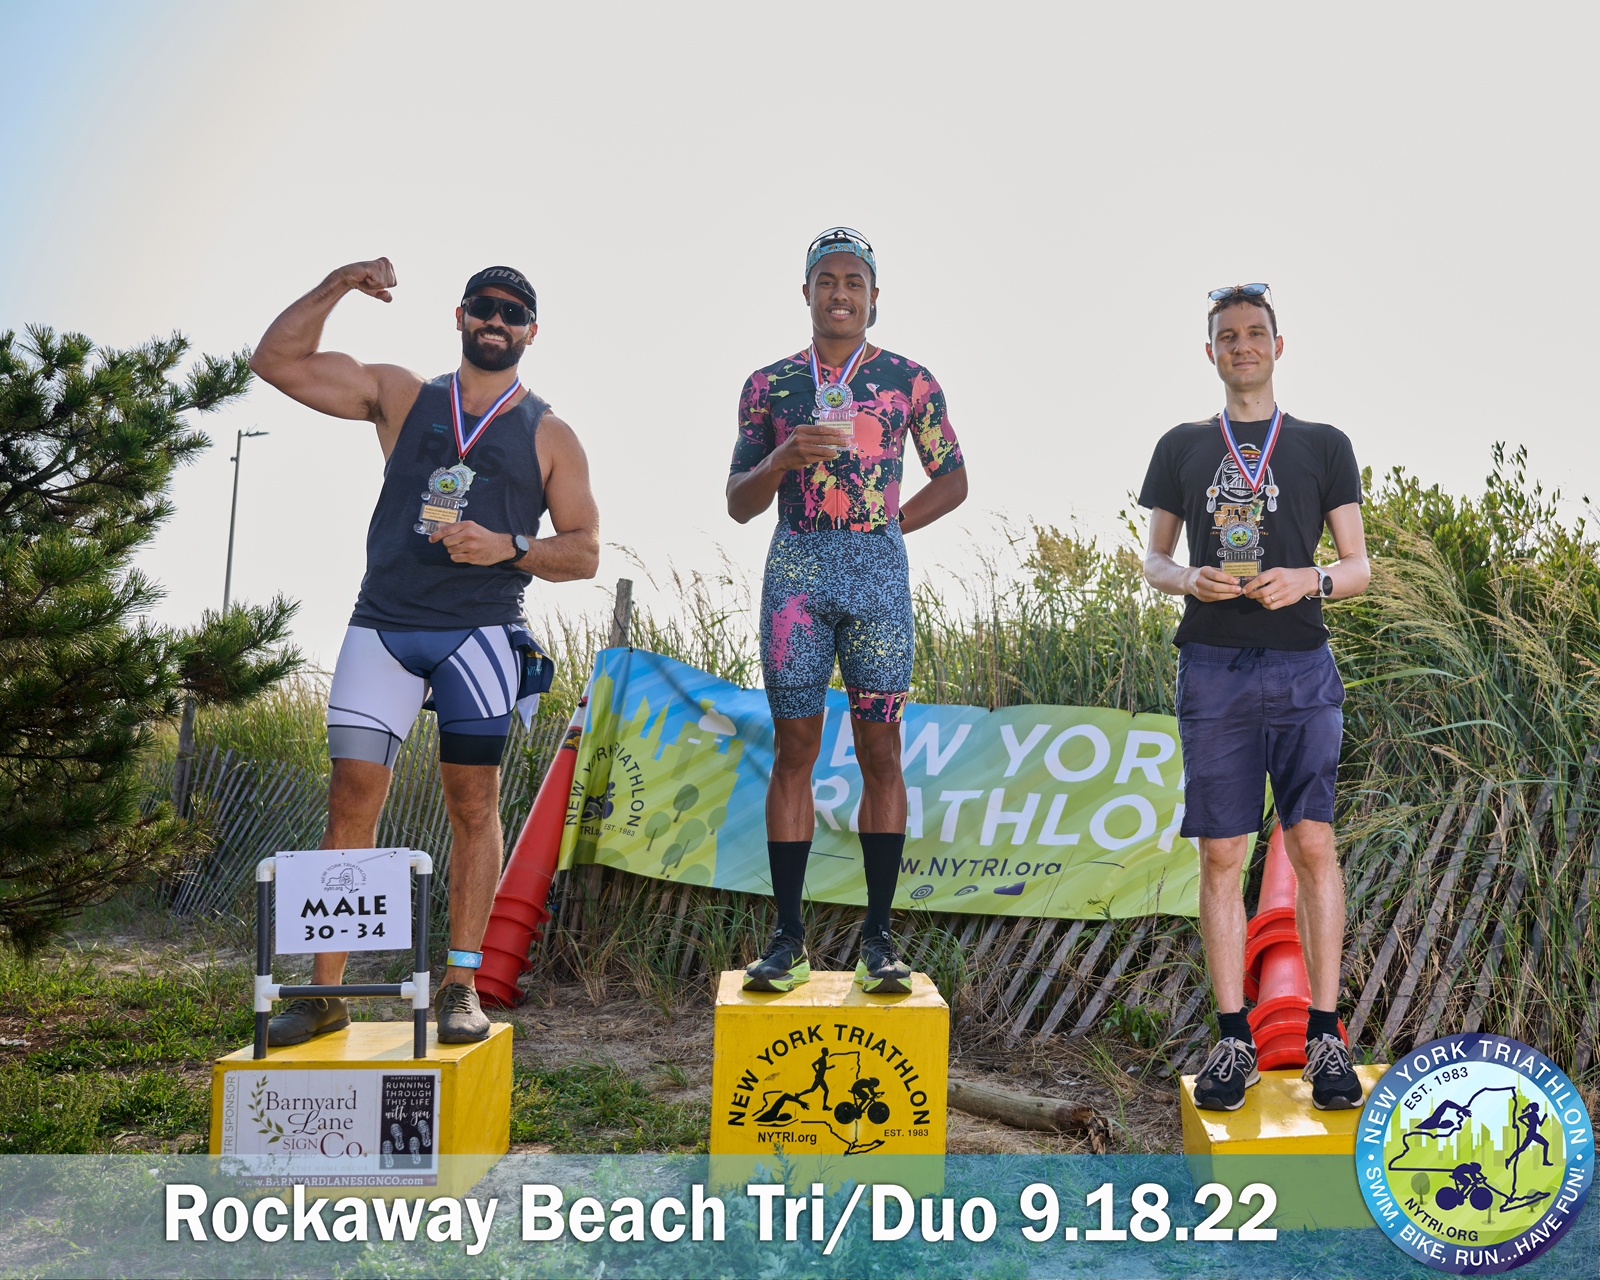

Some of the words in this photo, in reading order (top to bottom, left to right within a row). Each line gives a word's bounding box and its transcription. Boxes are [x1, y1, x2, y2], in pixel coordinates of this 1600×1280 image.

[1000, 724, 1186, 791] YOR
[565, 780, 585, 825] NEW
[613, 742, 645, 827] RIATHLON
[619, 827, 635, 837] 1983
[300, 895, 387, 919] MALE
[386, 1081, 431, 1089] RUNNING
[728, 1069, 759, 1127] NEW
[757, 1024, 824, 1066] YORK
[834, 1023, 930, 1126] TRIATHLON
[225, 1076, 236, 1132] SPONSOR
[266, 1089, 357, 1110] Barnyard
[385, 1090, 432, 1098] THROUGH
[386, 1098, 407, 1106] THIS
[410, 1098, 430, 1106] LIFE
[287, 1110, 354, 1135] Lane
[385, 1104, 408, 1121] with
[411, 1110, 431, 1127] you
[757, 1131, 817, 1145] NYTRI.org
[884, 1129, 905, 1137] EST.
[907, 1129, 929, 1137] 1983
[224, 1136, 234, 1153] TRI
[283, 1138, 318, 1150] SIGN
[320, 1132, 368, 1159] Co.
